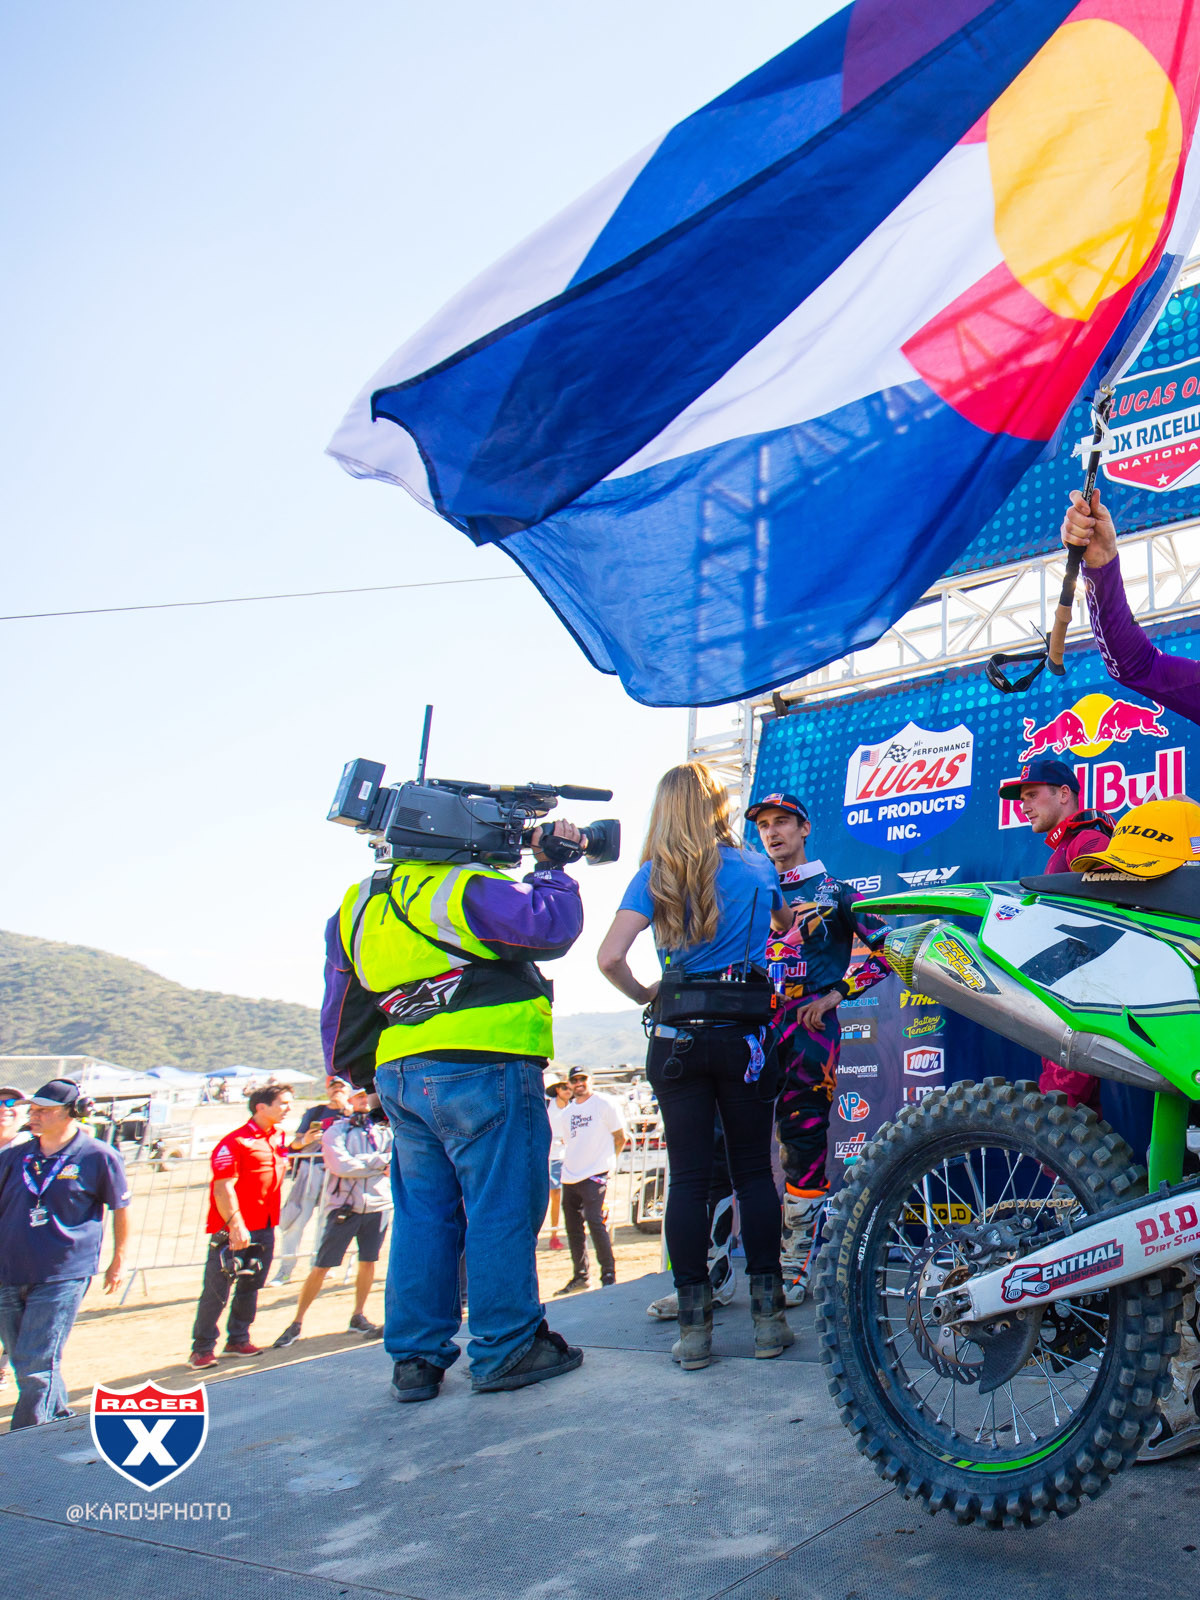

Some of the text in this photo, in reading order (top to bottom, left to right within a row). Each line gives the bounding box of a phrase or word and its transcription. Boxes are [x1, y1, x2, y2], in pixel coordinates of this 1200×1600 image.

[1110, 382, 1177, 419] LUCAS
[912, 741, 971, 757] PERFORMANCE
[856, 752, 967, 800] LUCAS
[1093, 746, 1186, 814] Bull
[847, 794, 966, 826] OIL PRODUCTS
[887, 823, 921, 841] INC.
[910, 879, 946, 887] RACING
[944, 938, 973, 965] PRO
[934, 941, 984, 990] CIRCUIT
[841, 997, 879, 1008] SUZUKI
[841, 1024, 871, 1032] oPro
[914, 1015, 940, 1027] Battery
[906, 1024, 936, 1039] Tender
[838, 1064, 878, 1075] Husqvarna
[910, 1053, 939, 1070] 100%
[838, 1091, 860, 1121] VP
[1136, 1204, 1199, 1245] D.I.D
[836, 1187, 870, 1283] DUNLOP
[1144, 1241, 1172, 1257] DIRT
